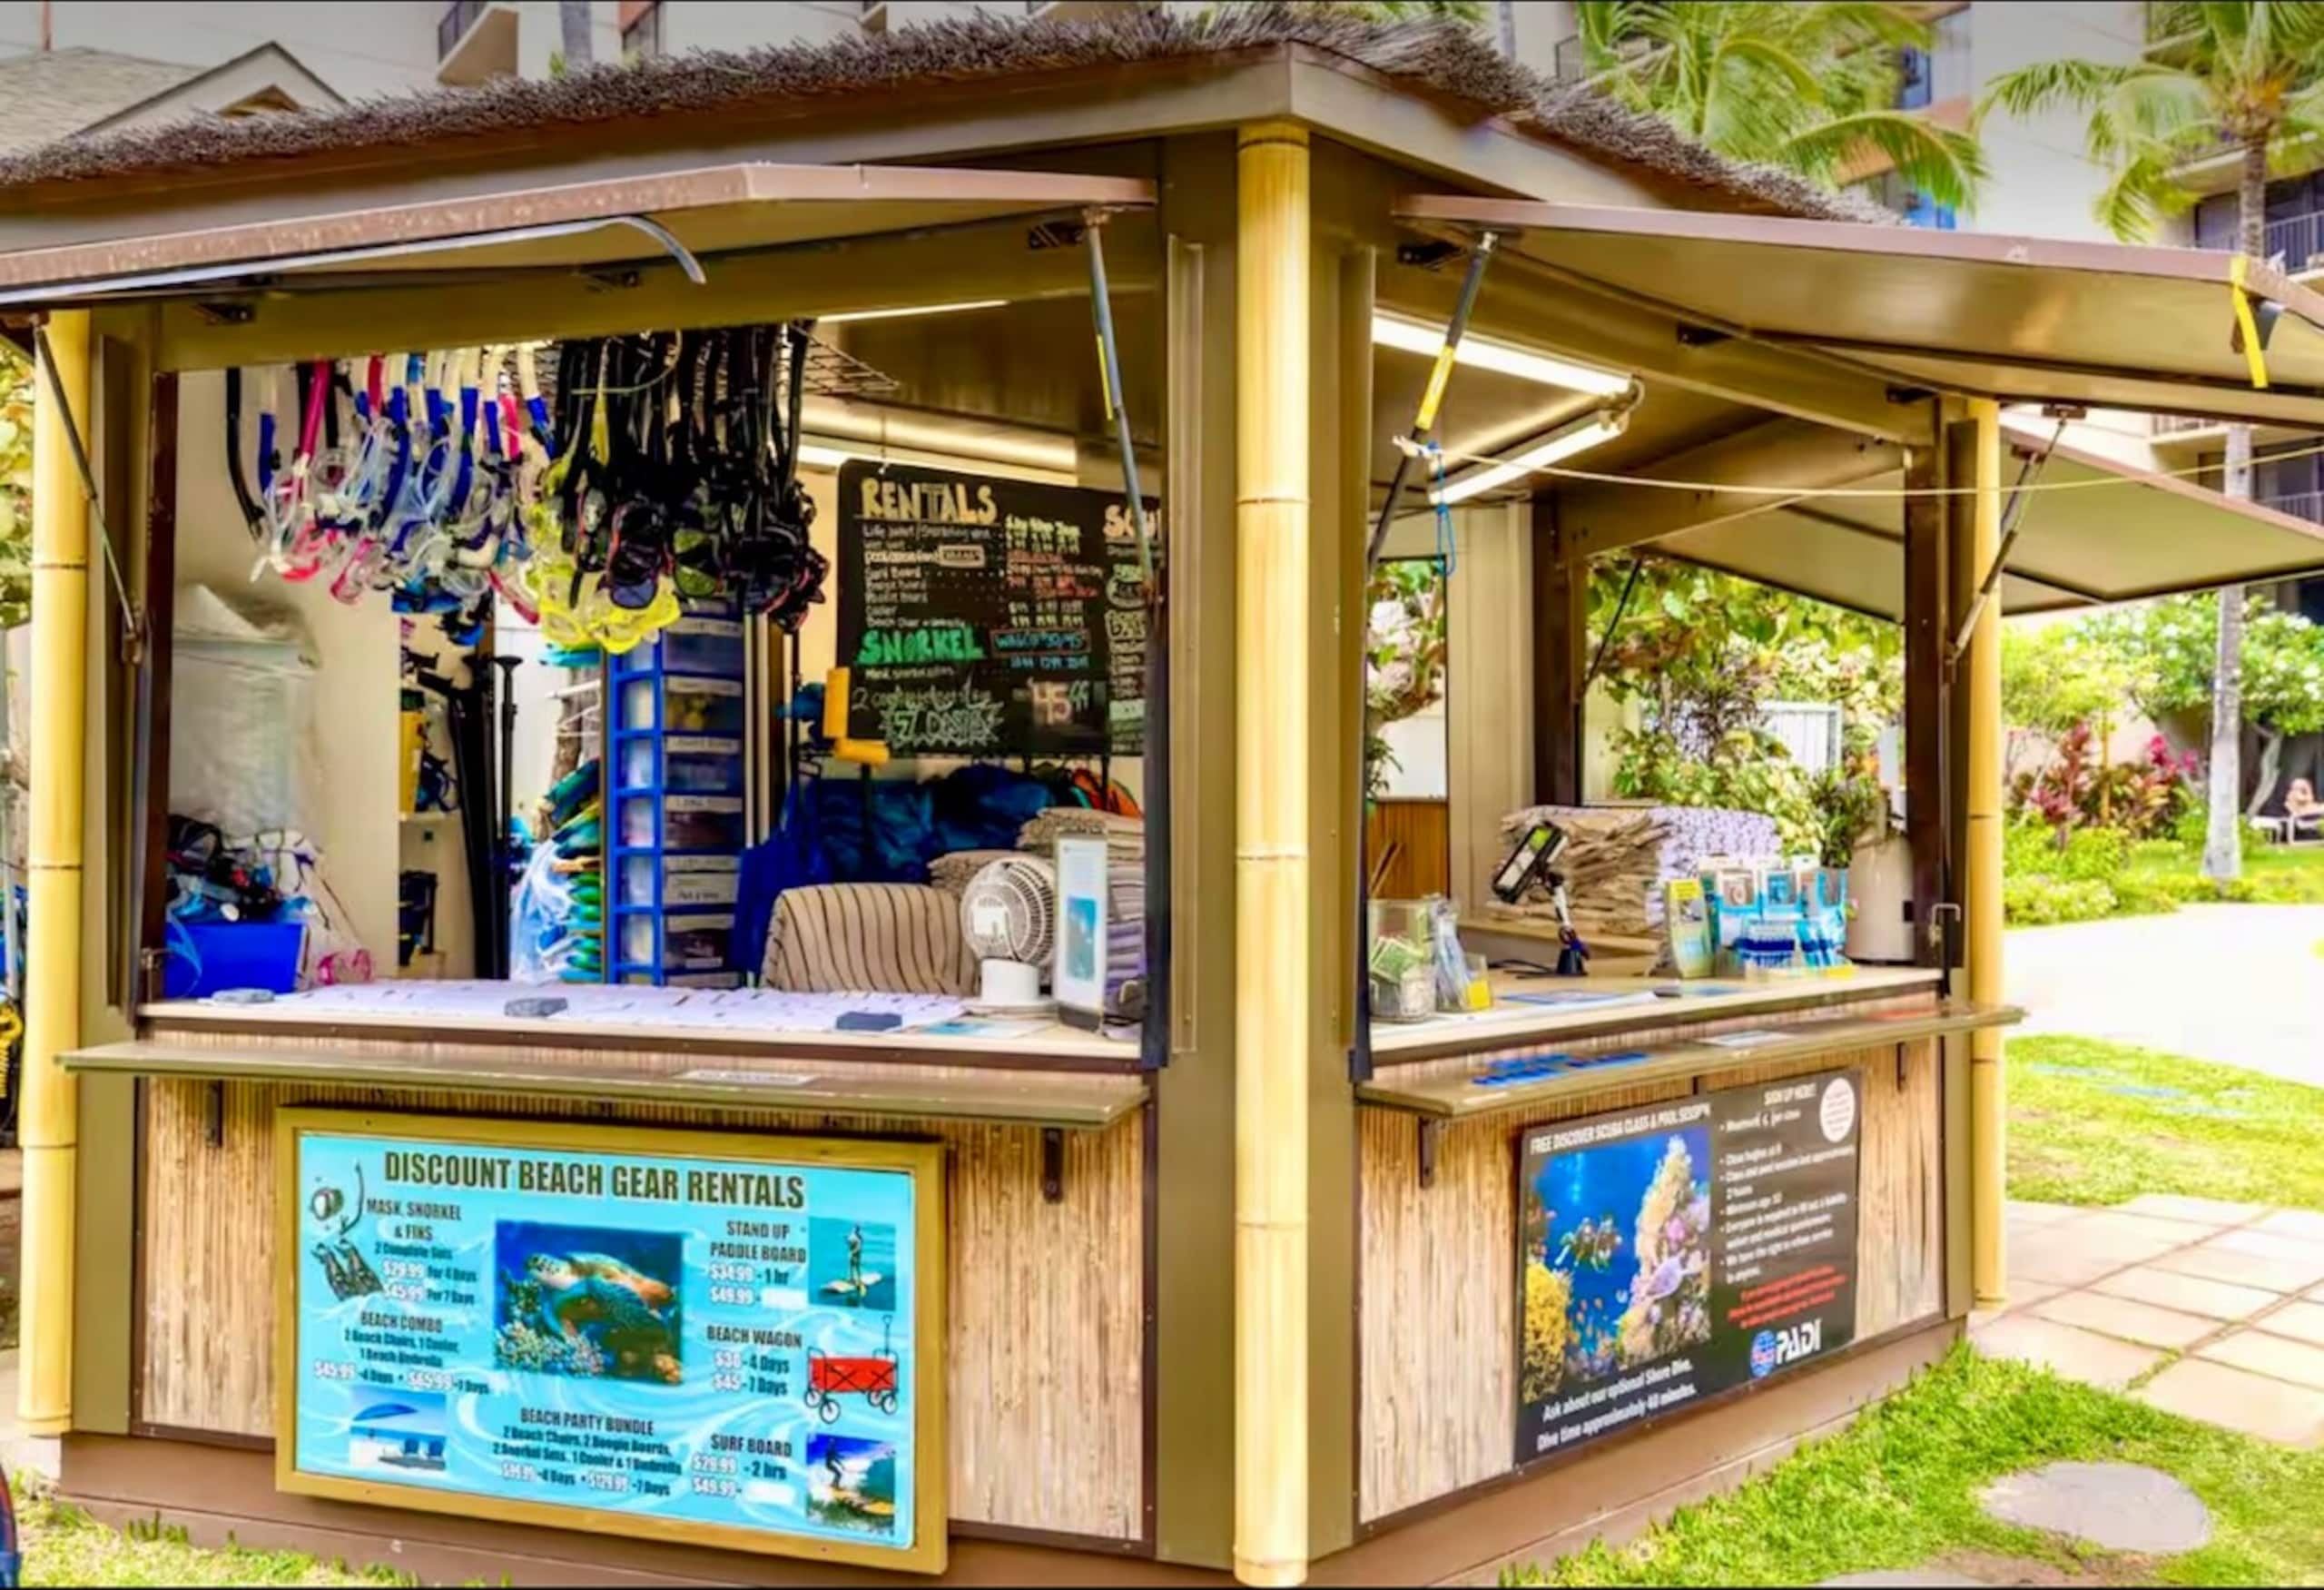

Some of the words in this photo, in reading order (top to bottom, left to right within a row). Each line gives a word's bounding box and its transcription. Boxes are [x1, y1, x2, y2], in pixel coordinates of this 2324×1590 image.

[862, 477, 998, 525] RENTALS
[857, 626, 985, 665] SNORKEL
[1530, 1135, 1553, 1155] FREE
[1553, 1126, 1594, 1151] DISCOVER
[1595, 1121, 1624, 1141] SCUBA
[1624, 1114, 1649, 1135] CLASS
[384, 1151, 512, 1190] DISCOUNT
[518, 1159, 604, 1196] BEACH
[611, 1165, 679, 1201] GEAR
[686, 1170, 805, 1210] RENTALS
[407, 1201, 462, 1221] SNORKEL
[405, 1224, 434, 1241] FINS
[726, 1220, 769, 1239] STAND
[772, 1222, 791, 1239] UP
[709, 1241, 758, 1260] PADDLE
[761, 1245, 807, 1264] BOARD
[360, 1309, 398, 1328] BEACH
[400, 1314, 443, 1334] COMBO
[706, 1325, 750, 1344] BEACH
[752, 1328, 803, 1348] WAGON
[1775, 1317, 1823, 1365] PADI
[759, 1356, 790, 1375] Days
[757, 1377, 789, 1397] Days
[1542, 1401, 1562, 1422] Ask
[1561, 1391, 1590, 1415] about
[520, 1407, 561, 1426] BEACH
[563, 1411, 603, 1431] PARTY
[606, 1416, 655, 1437] BUNDLE
[710, 1433, 744, 1452] SURF
[746, 1437, 793, 1457] BOARD
[751, 1459, 761, 1477] 2
[763, 1461, 787, 1480] hrs
